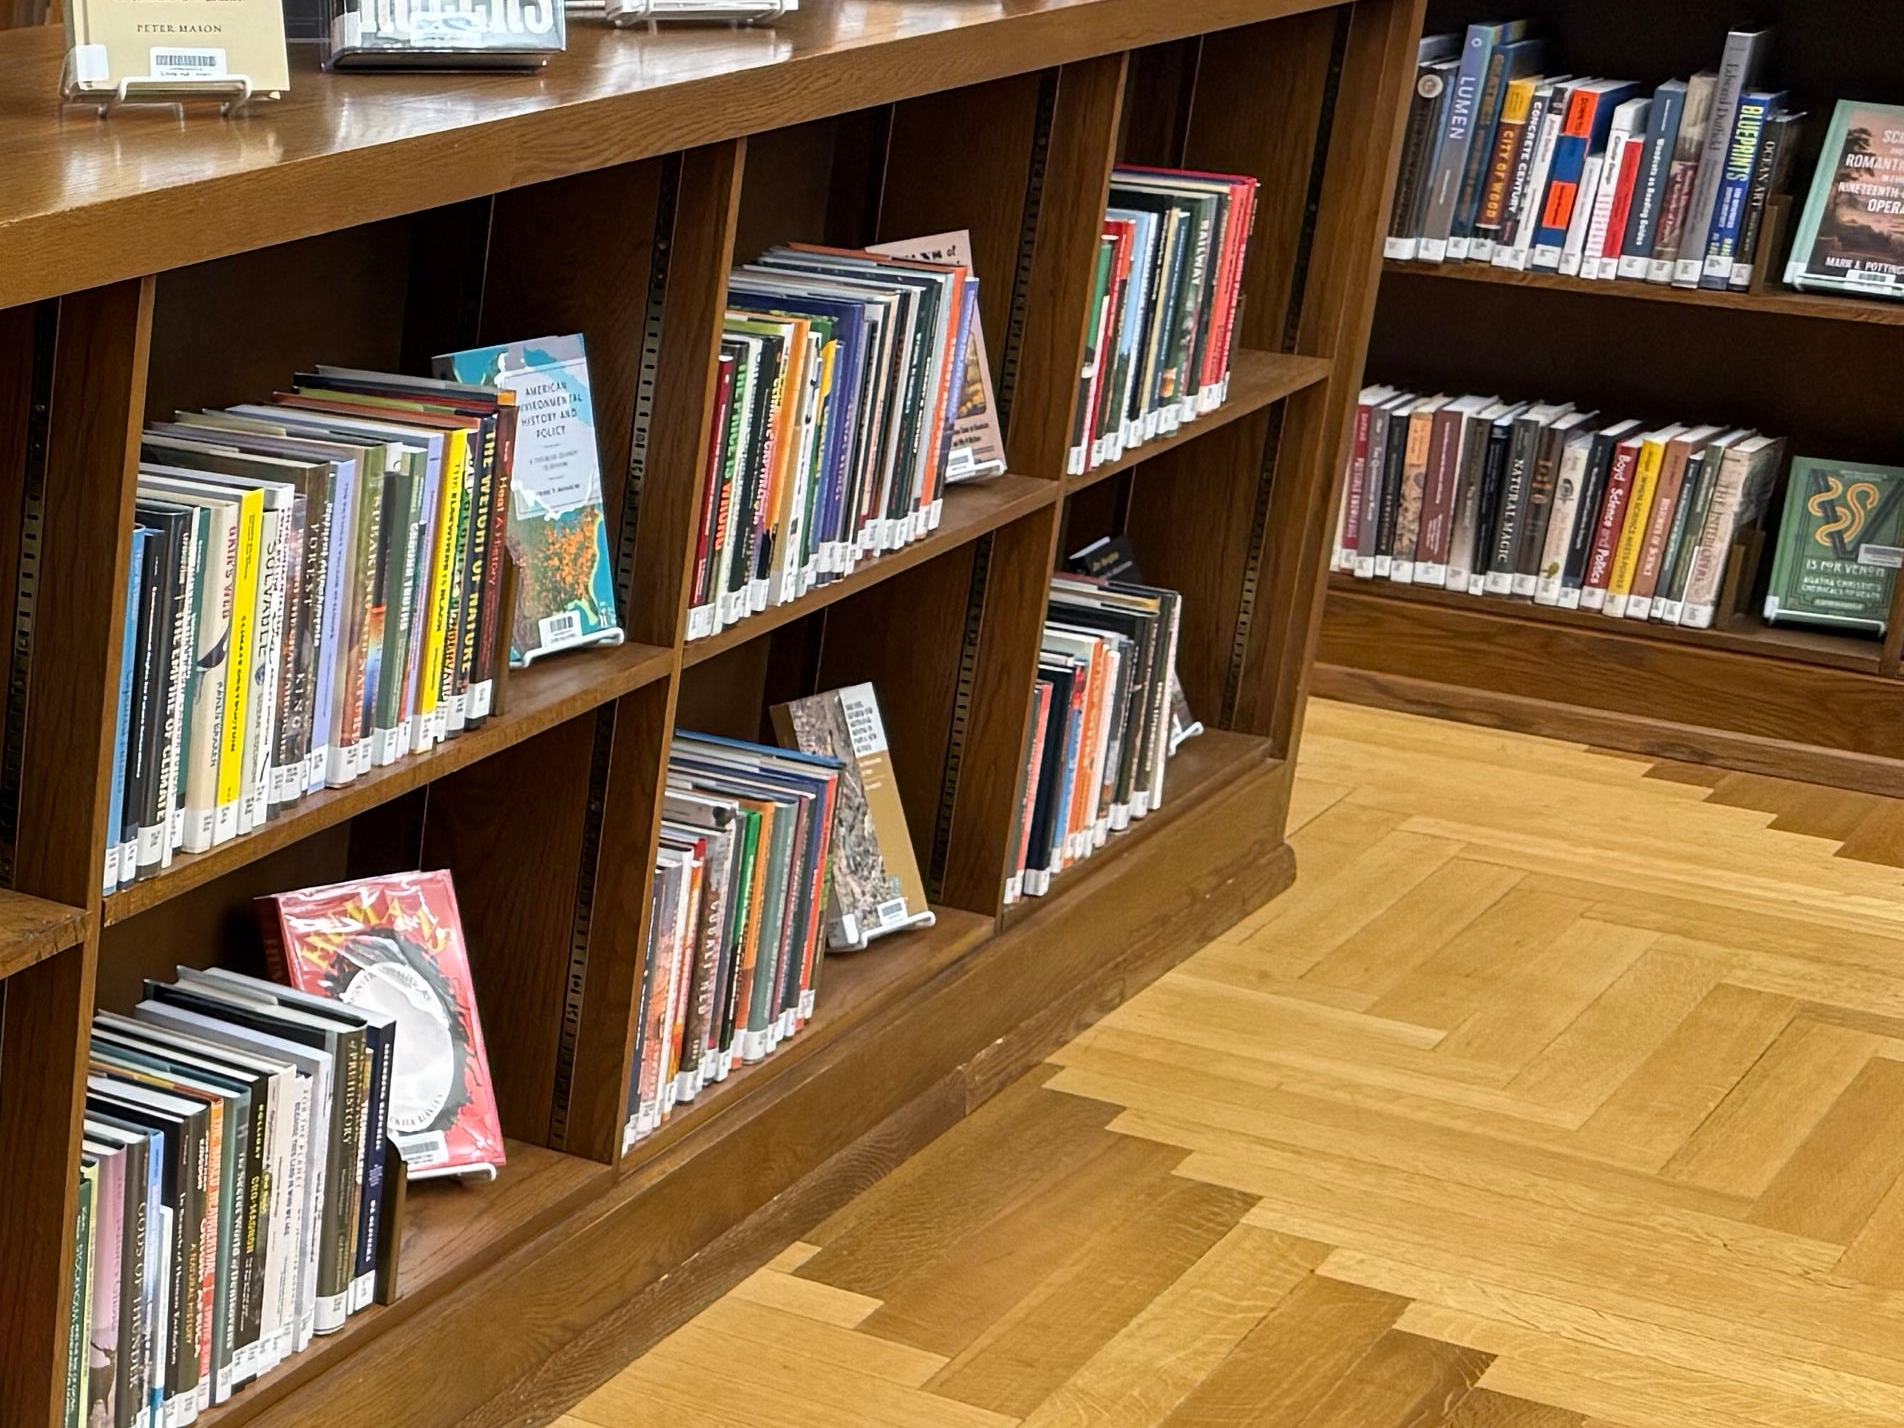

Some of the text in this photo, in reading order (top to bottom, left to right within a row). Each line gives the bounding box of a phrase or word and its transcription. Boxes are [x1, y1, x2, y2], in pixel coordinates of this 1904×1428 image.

[1449, 76, 1476, 140] LUMEN
[1726, 104, 1764, 182] BLUEPRINTS
[1498, 458, 1525, 563] NATURAL MAGIC
